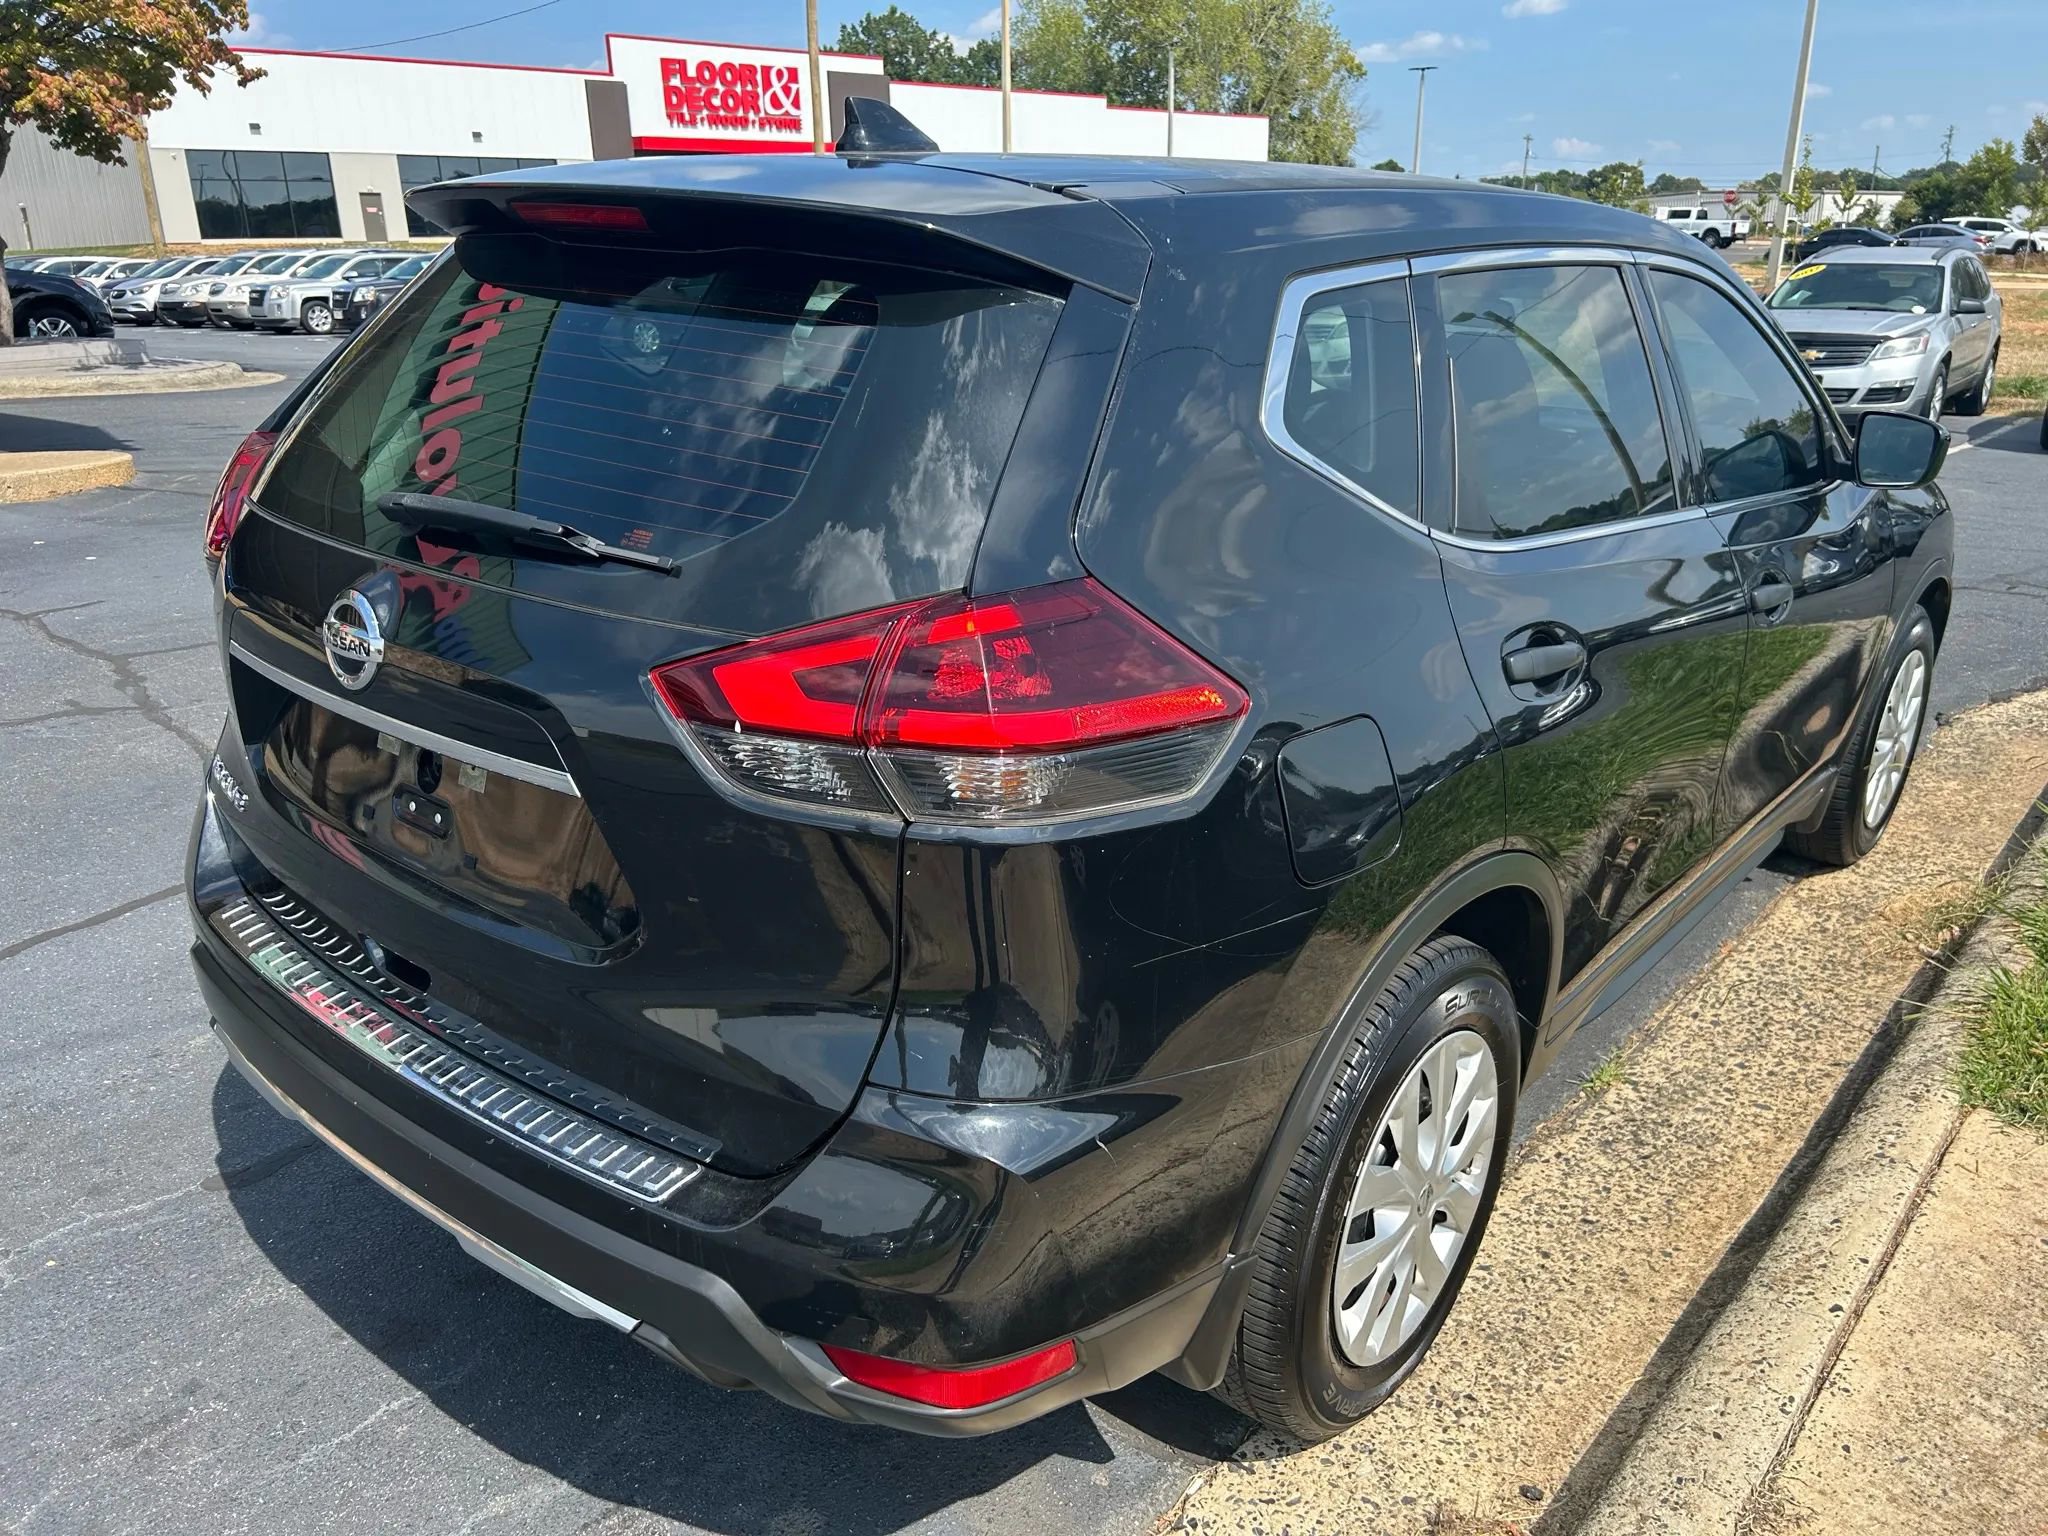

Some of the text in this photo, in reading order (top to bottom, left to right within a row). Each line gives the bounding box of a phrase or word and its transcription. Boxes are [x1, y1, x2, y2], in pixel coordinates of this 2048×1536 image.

[660, 58, 759, 90] FLOOR
[664, 84, 760, 116] DECOR
[762, 66, 801, 117] &
[666, 112, 802, 133] TILE WOOD STONE
[323, 622, 370, 657] NISSAN
